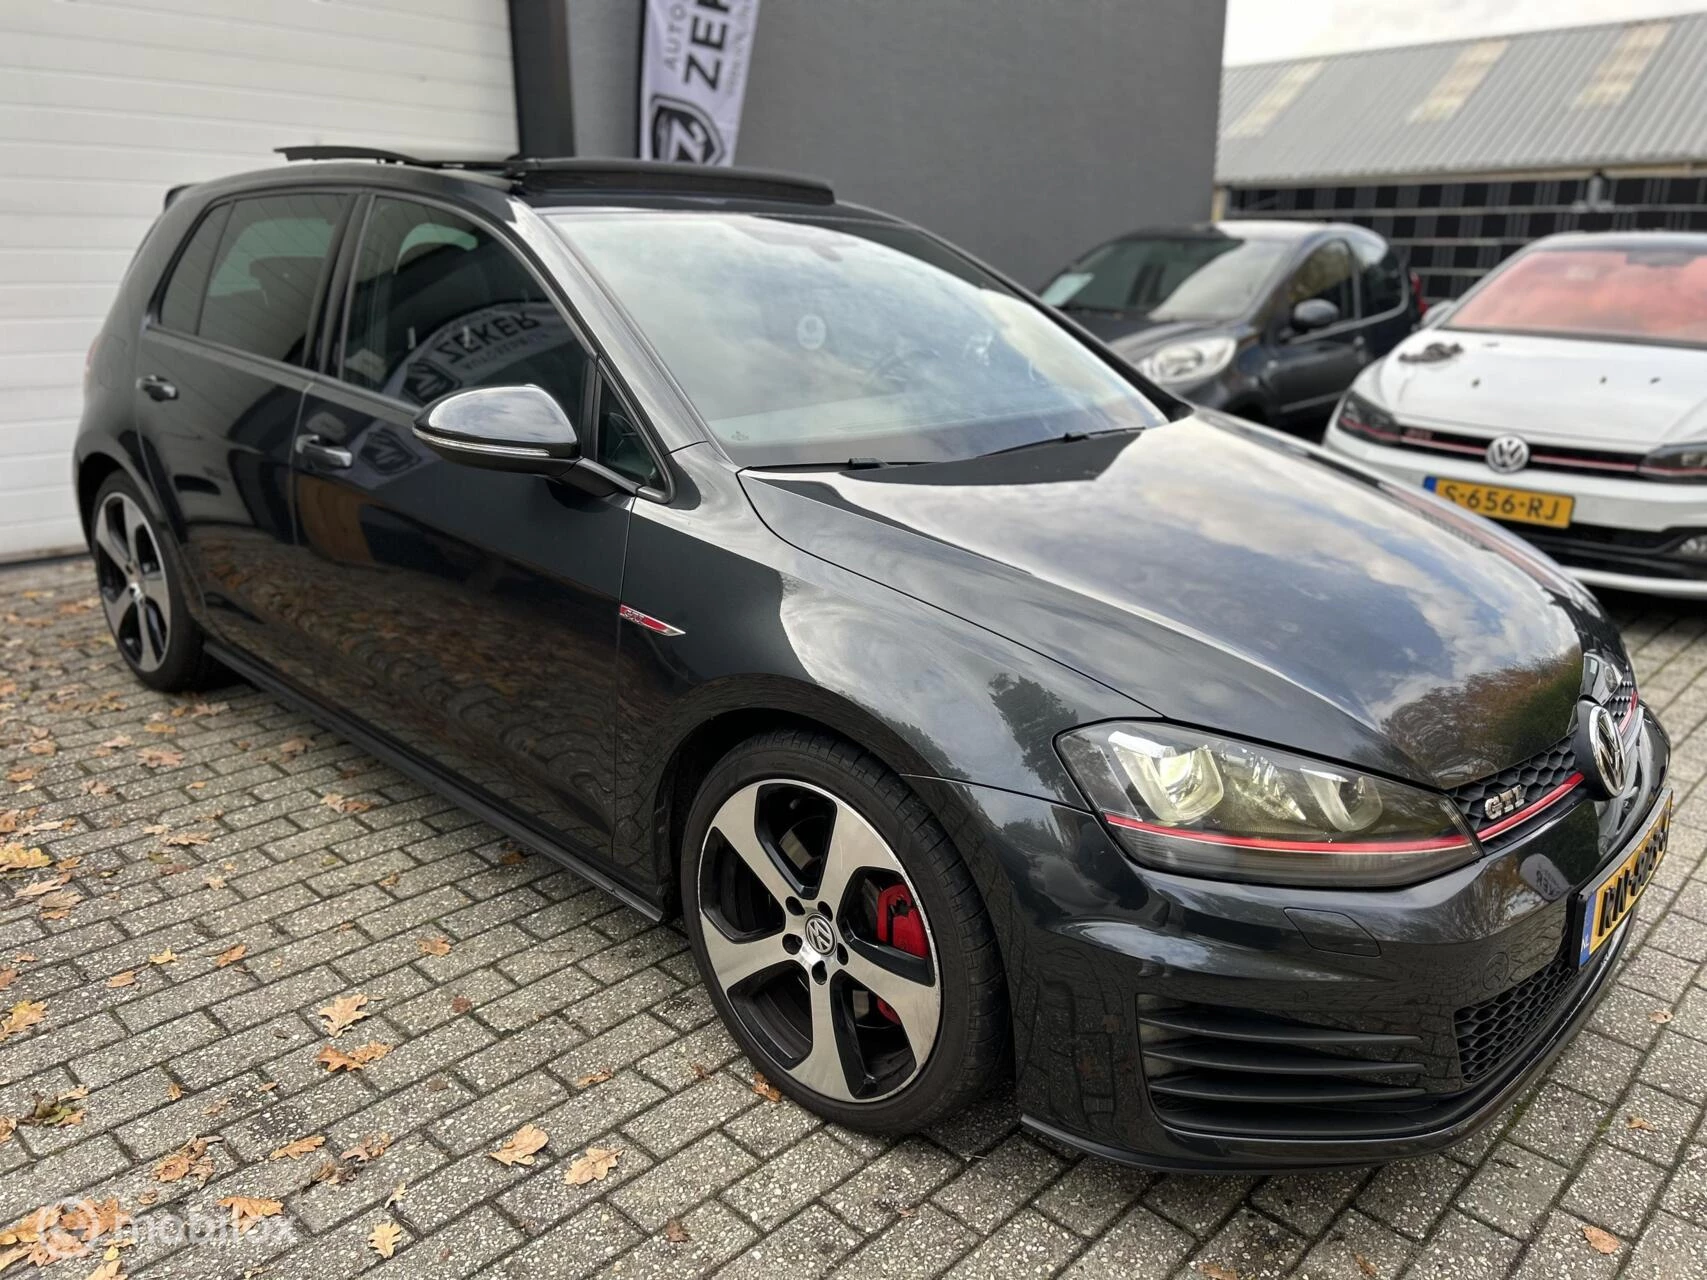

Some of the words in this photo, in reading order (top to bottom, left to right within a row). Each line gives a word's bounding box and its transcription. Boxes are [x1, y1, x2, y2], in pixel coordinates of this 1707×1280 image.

[664, 4, 688, 72] AUTO
[1444, 484, 1561, 521] S-656-RJ
[1485, 784, 1525, 820] GTI
